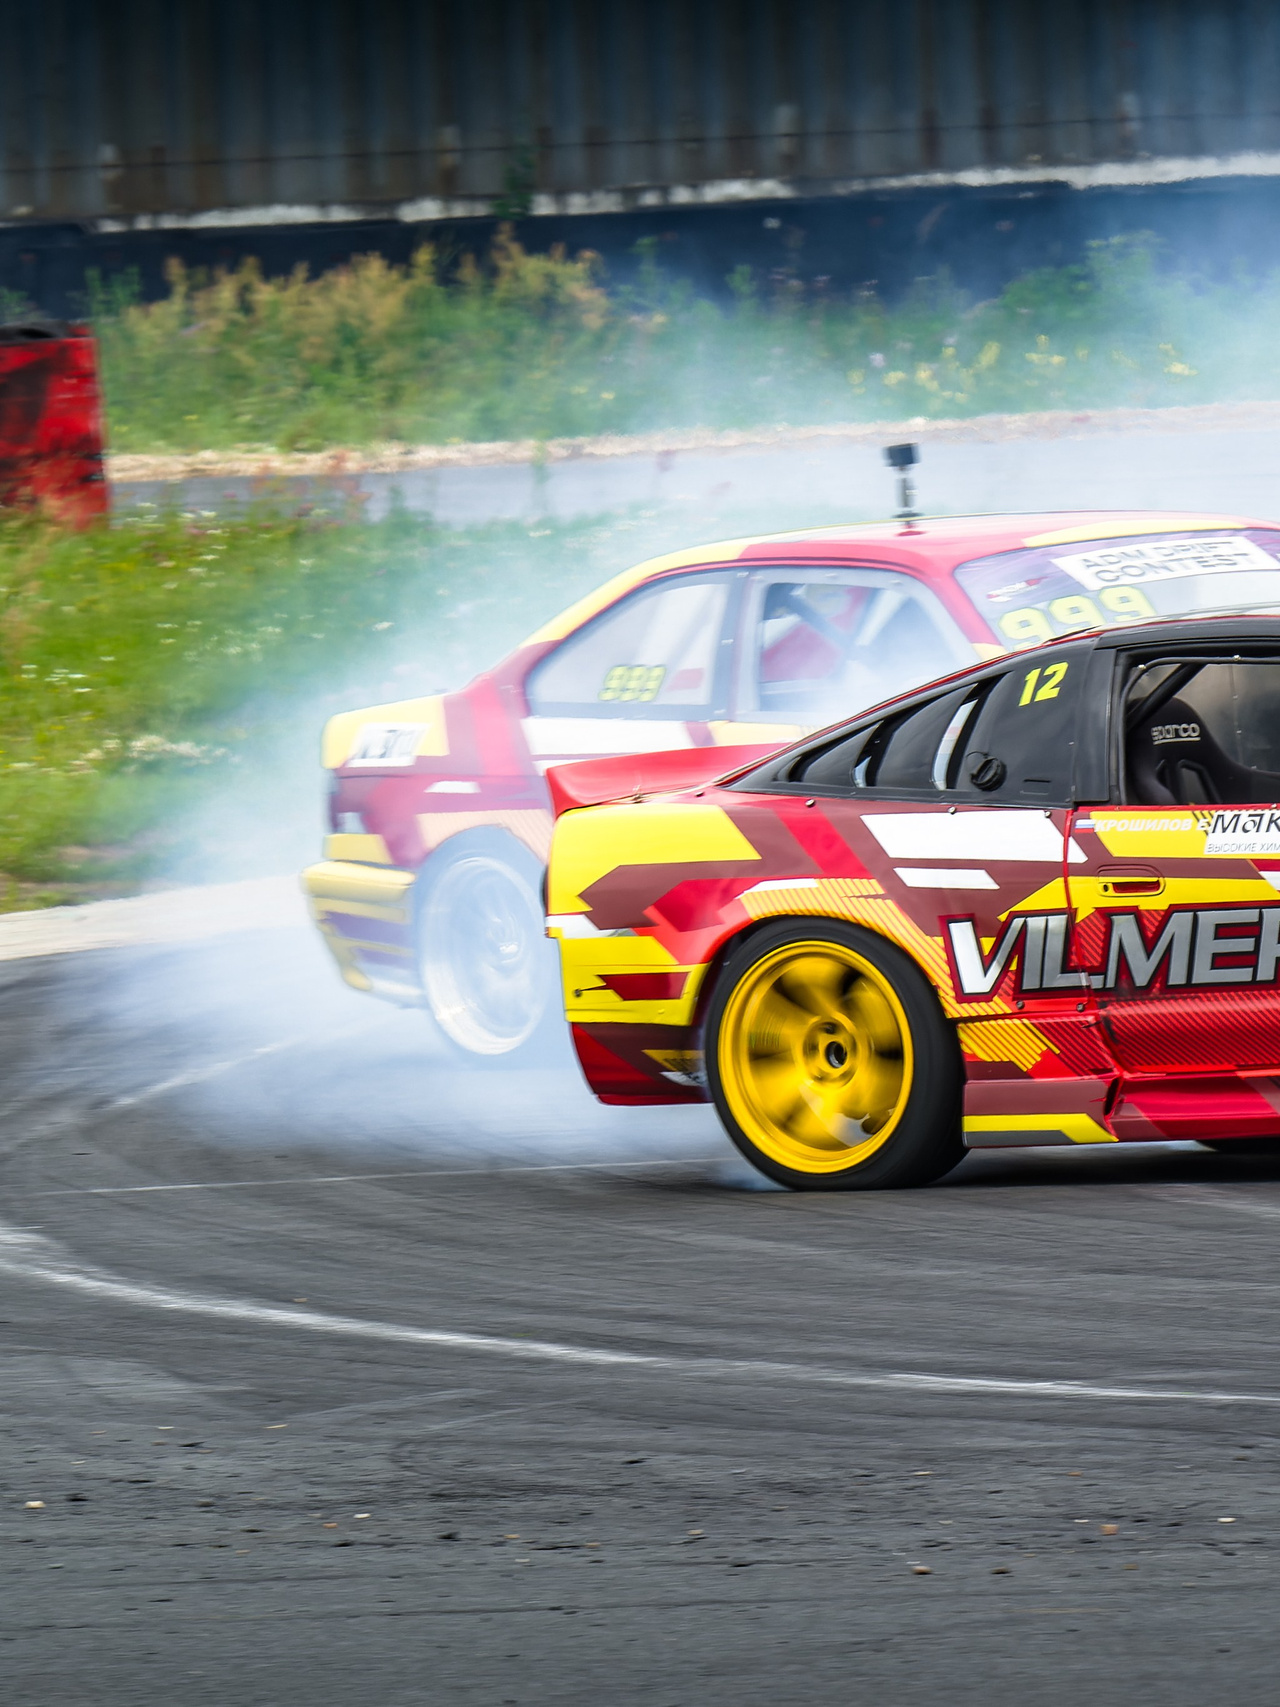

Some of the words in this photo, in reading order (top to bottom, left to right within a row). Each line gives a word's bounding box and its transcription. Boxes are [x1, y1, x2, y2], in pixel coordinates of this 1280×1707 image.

[1095, 552, 1256, 583] CONTEST
[999, 585, 1158, 650] 999
[1018, 661, 1069, 707] 12
[1150, 723, 1200, 742] sparco
[1093, 818, 1193, 833] КРОШИЛОВ
[1207, 842, 1257, 853] ВЫСОКИЕ
